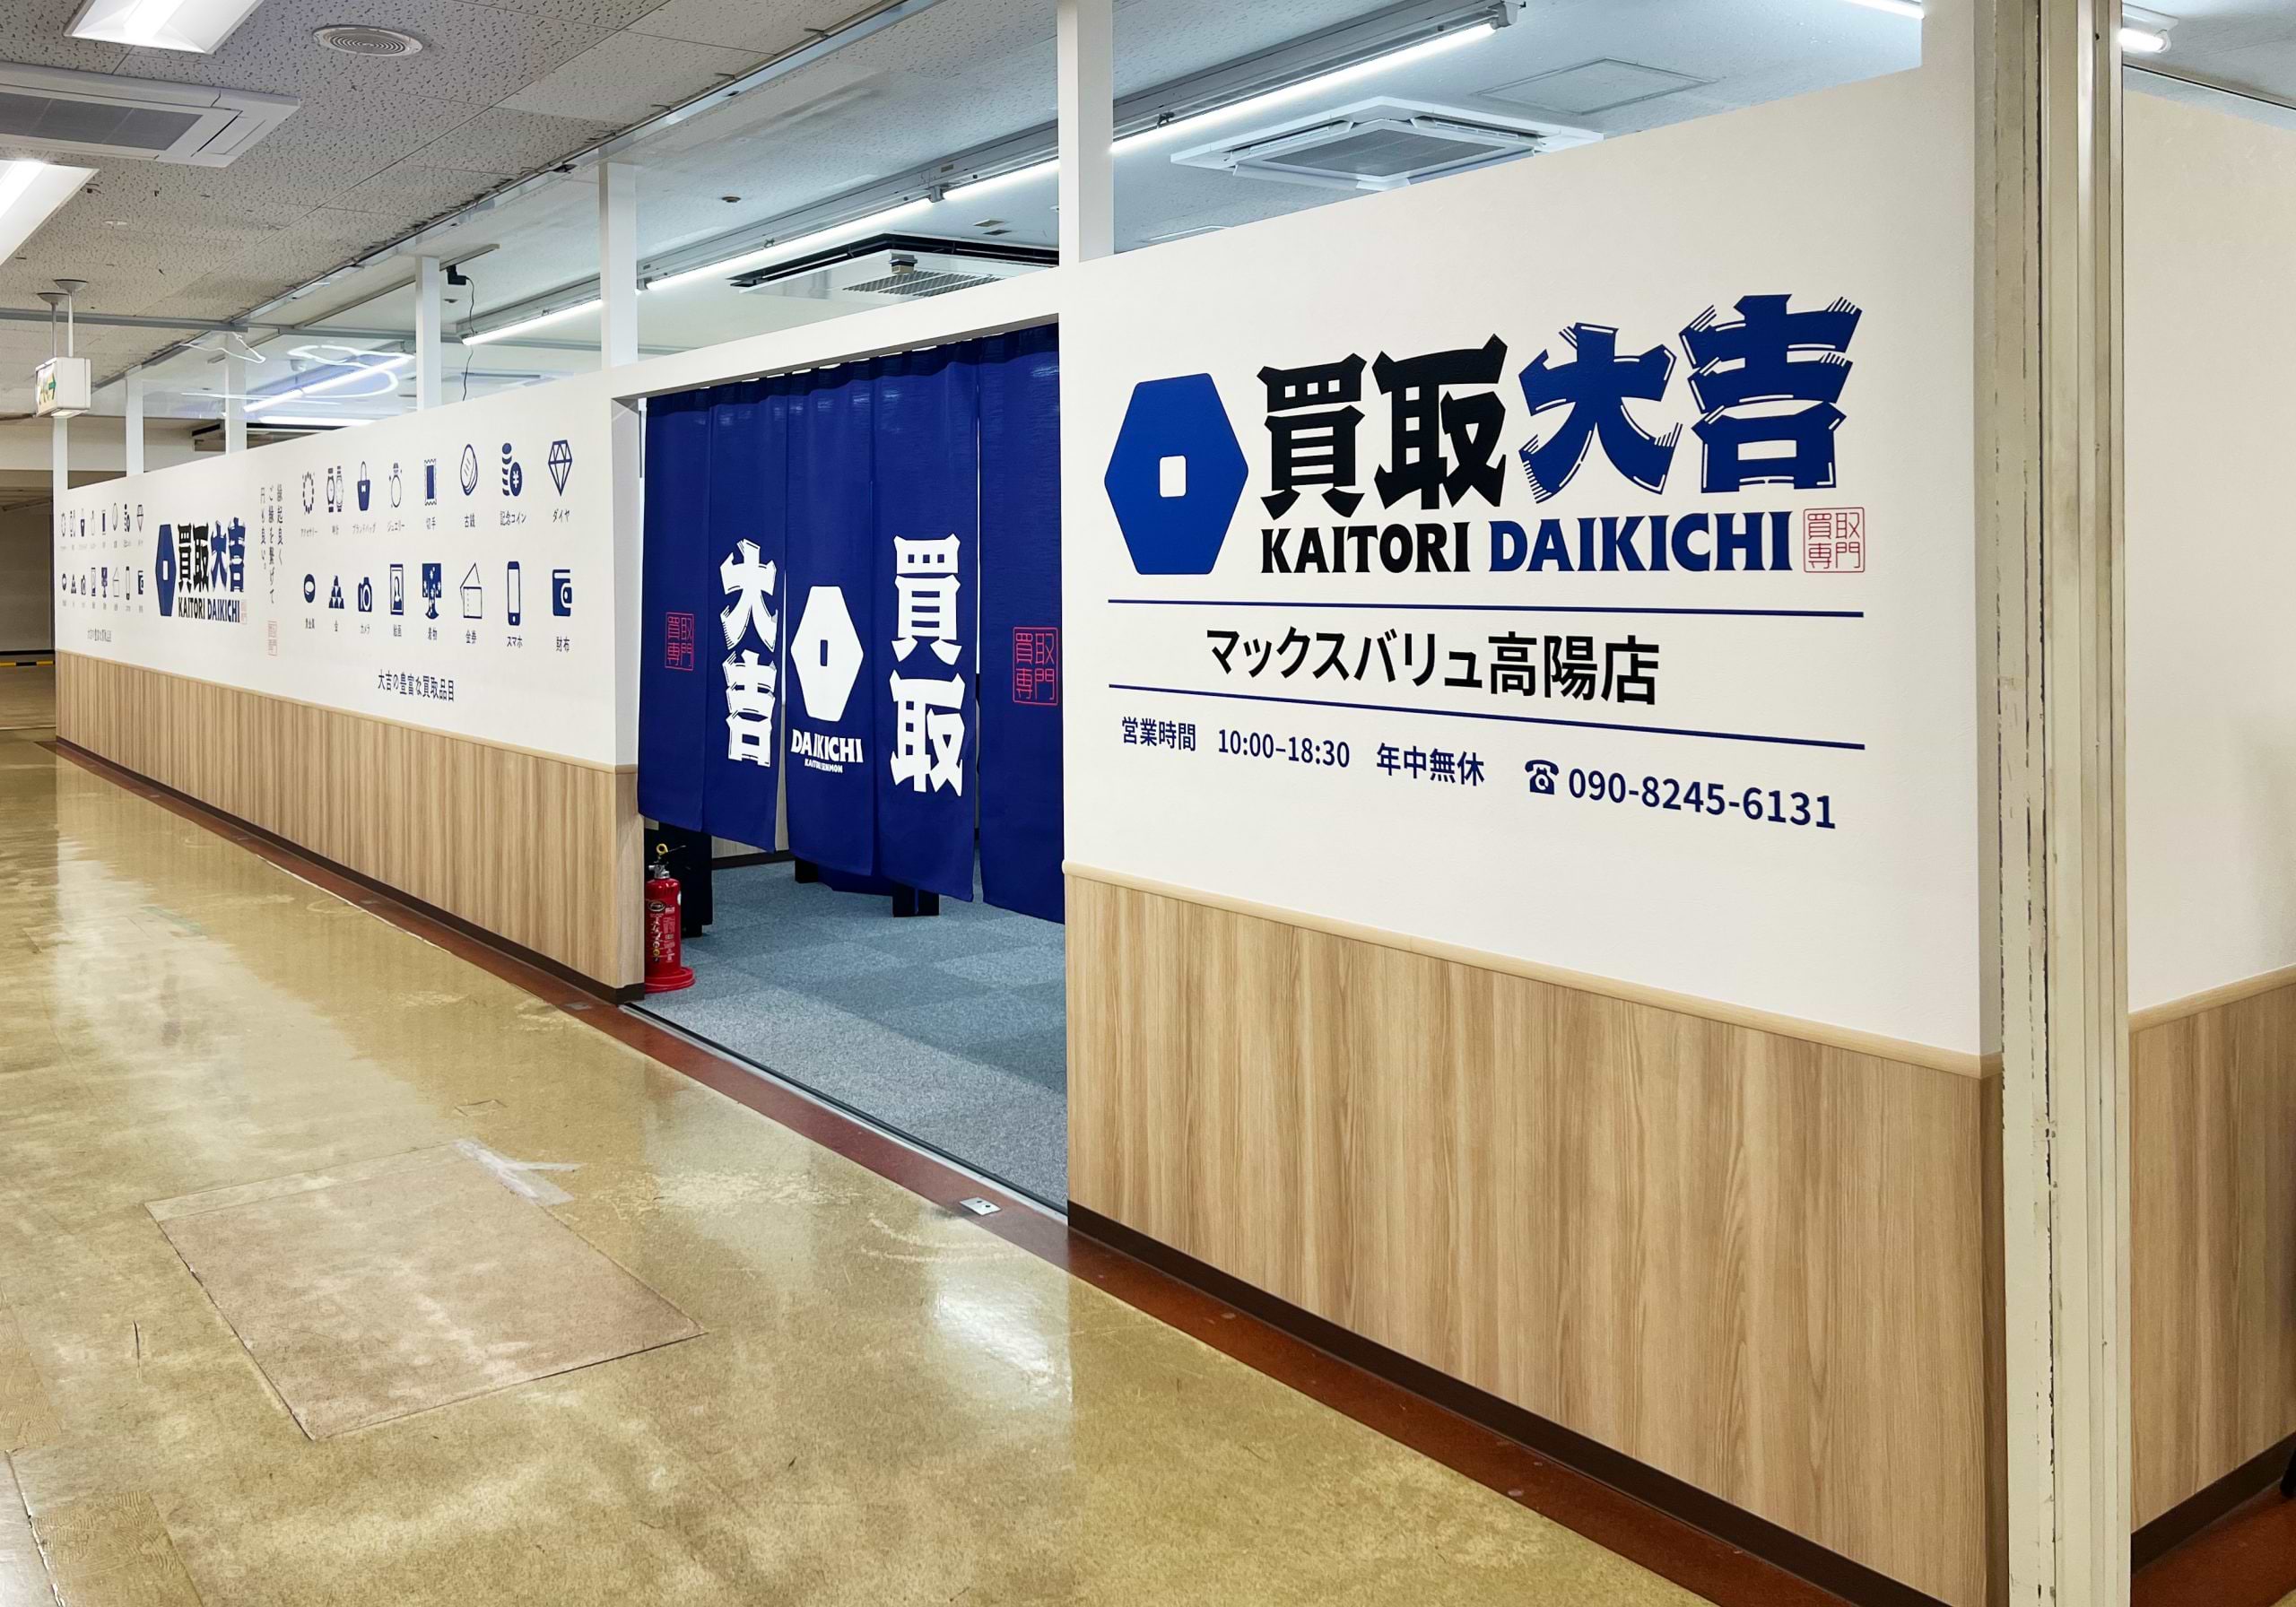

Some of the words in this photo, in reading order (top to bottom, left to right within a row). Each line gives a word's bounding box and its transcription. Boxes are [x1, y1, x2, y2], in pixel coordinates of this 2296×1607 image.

[1257, 293, 1865, 520] 買取大吉
[500, 510, 527, 526] 記念コイン
[552, 508, 570, 524] ダイヤ
[1806, 513, 1861, 540] 買取
[178, 517, 247, 594] 買取大吉
[1261, 521, 1472, 574] KAITORI
[1488, 510, 1794, 573] DAIKICHI
[178, 596, 206, 621] KAITORI
[207, 599, 240, 623] DAIKICHI
[507, 635, 524, 649] スマホ
[555, 637, 570, 654] 財布
[719, 538, 778, 768] 大吉
[890, 534, 966, 796] 買取
[1206, 624, 1660, 707] マックスバリュ高陽店
[378, 669, 455, 702] 大吉の豊富な買取品目
[790, 728, 864, 763] DAIKICHI
[1121, 716, 1197, 752] 営業時間
[1376, 742, 1485, 787] 年中無休
[1568, 766, 1837, 830] 090-8245-6131
